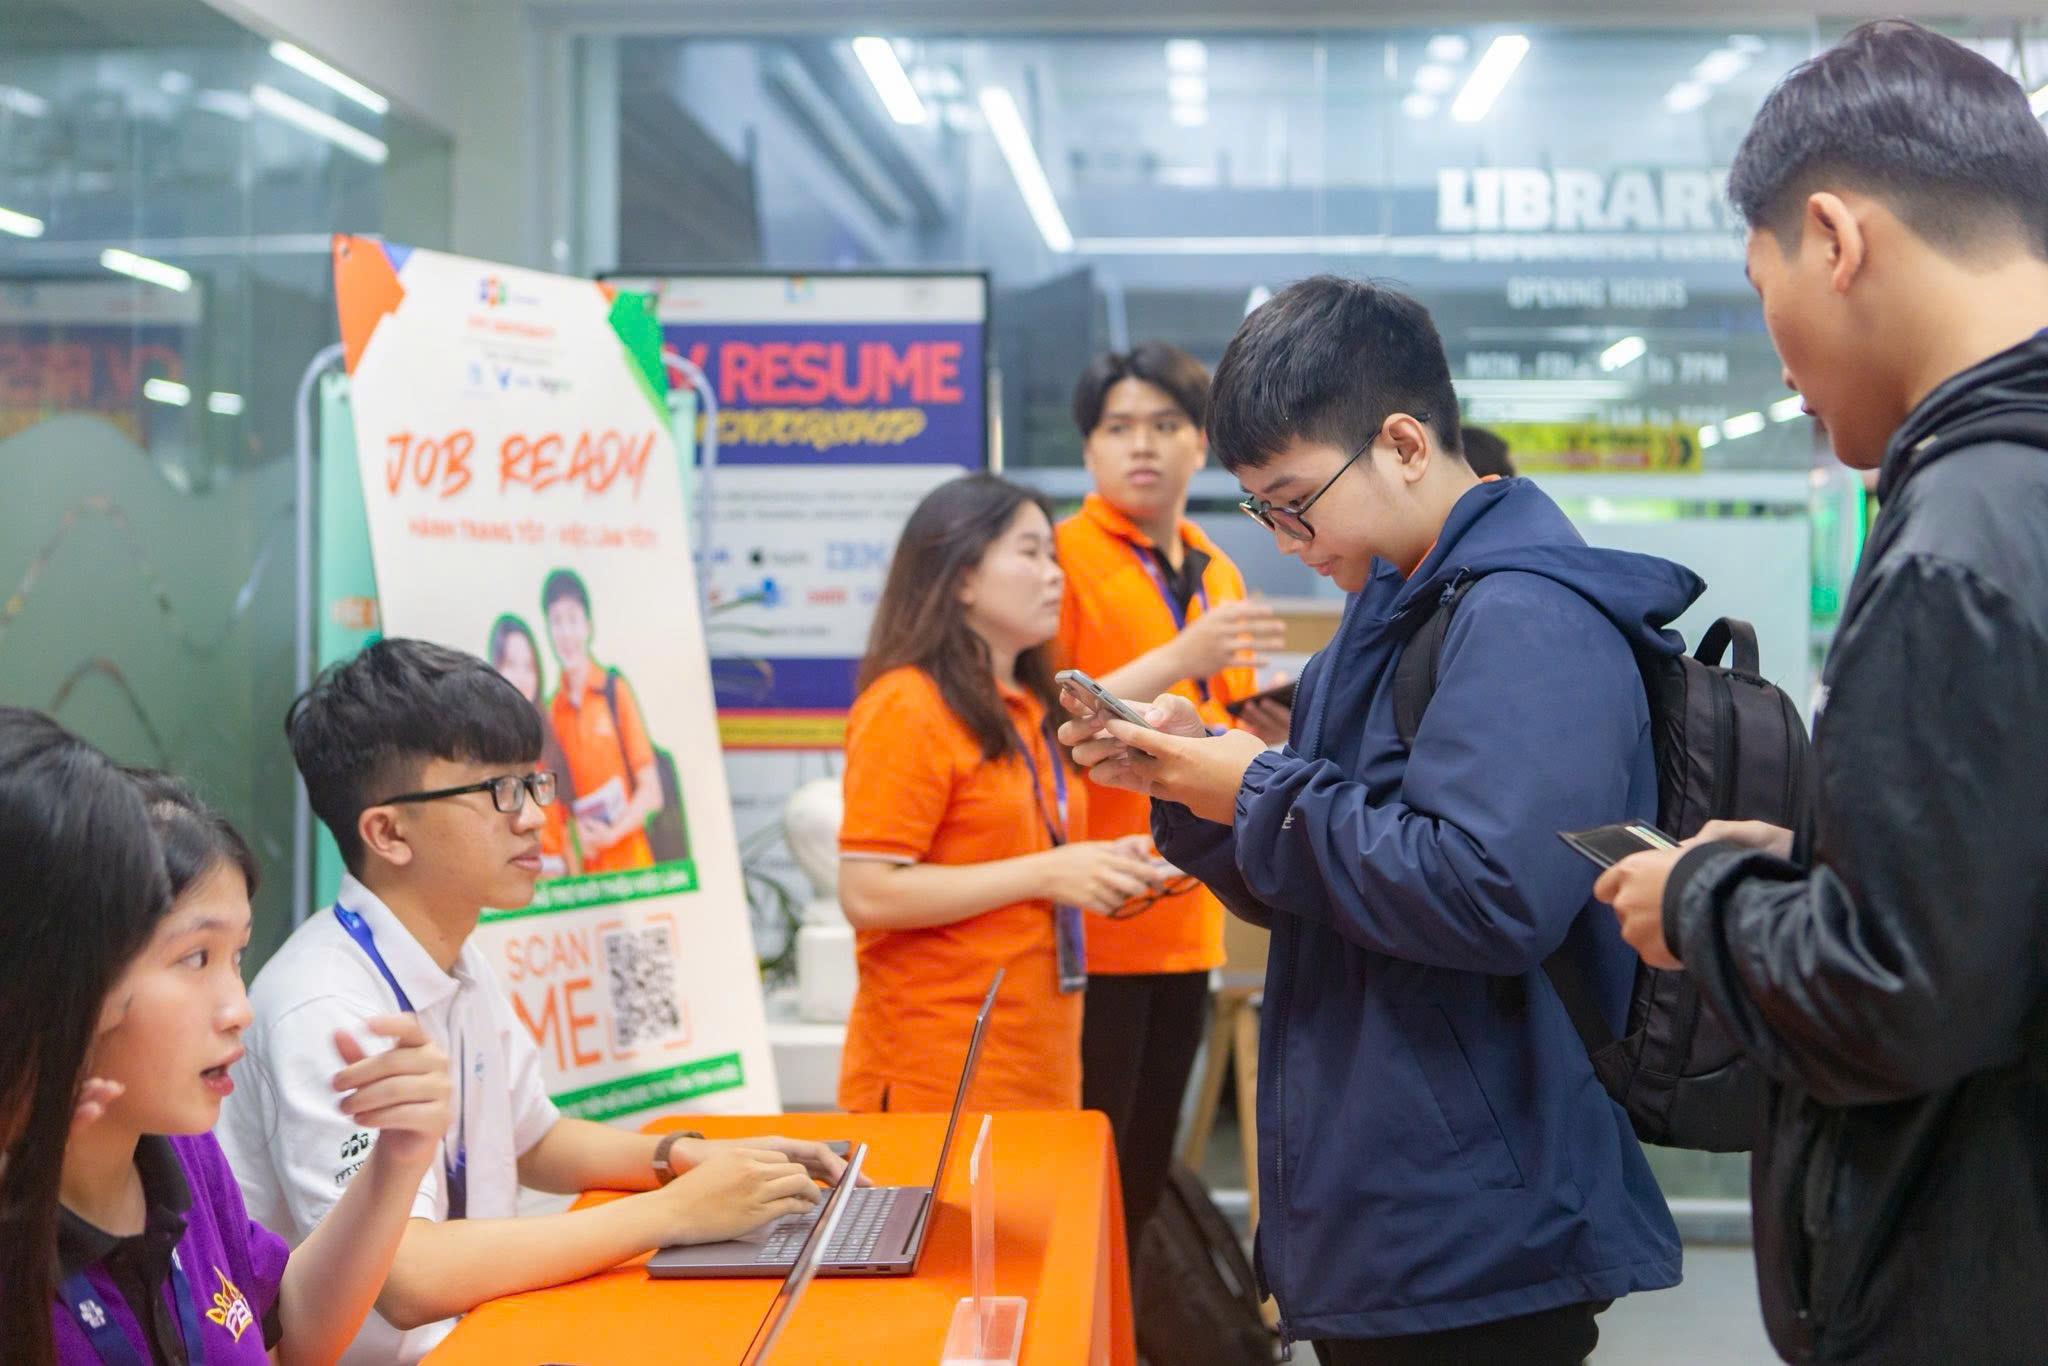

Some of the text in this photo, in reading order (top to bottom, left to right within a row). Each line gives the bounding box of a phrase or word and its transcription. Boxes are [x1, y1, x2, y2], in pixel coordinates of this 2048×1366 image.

[1506, 276, 1688, 309] OPENING HOURS
[718, 341, 963, 404] RESUME
[386, 429, 474, 499] JOB
[499, 429, 656, 501] READY
[505, 927, 592, 981] SCAN
[511, 976, 603, 1073] ME
